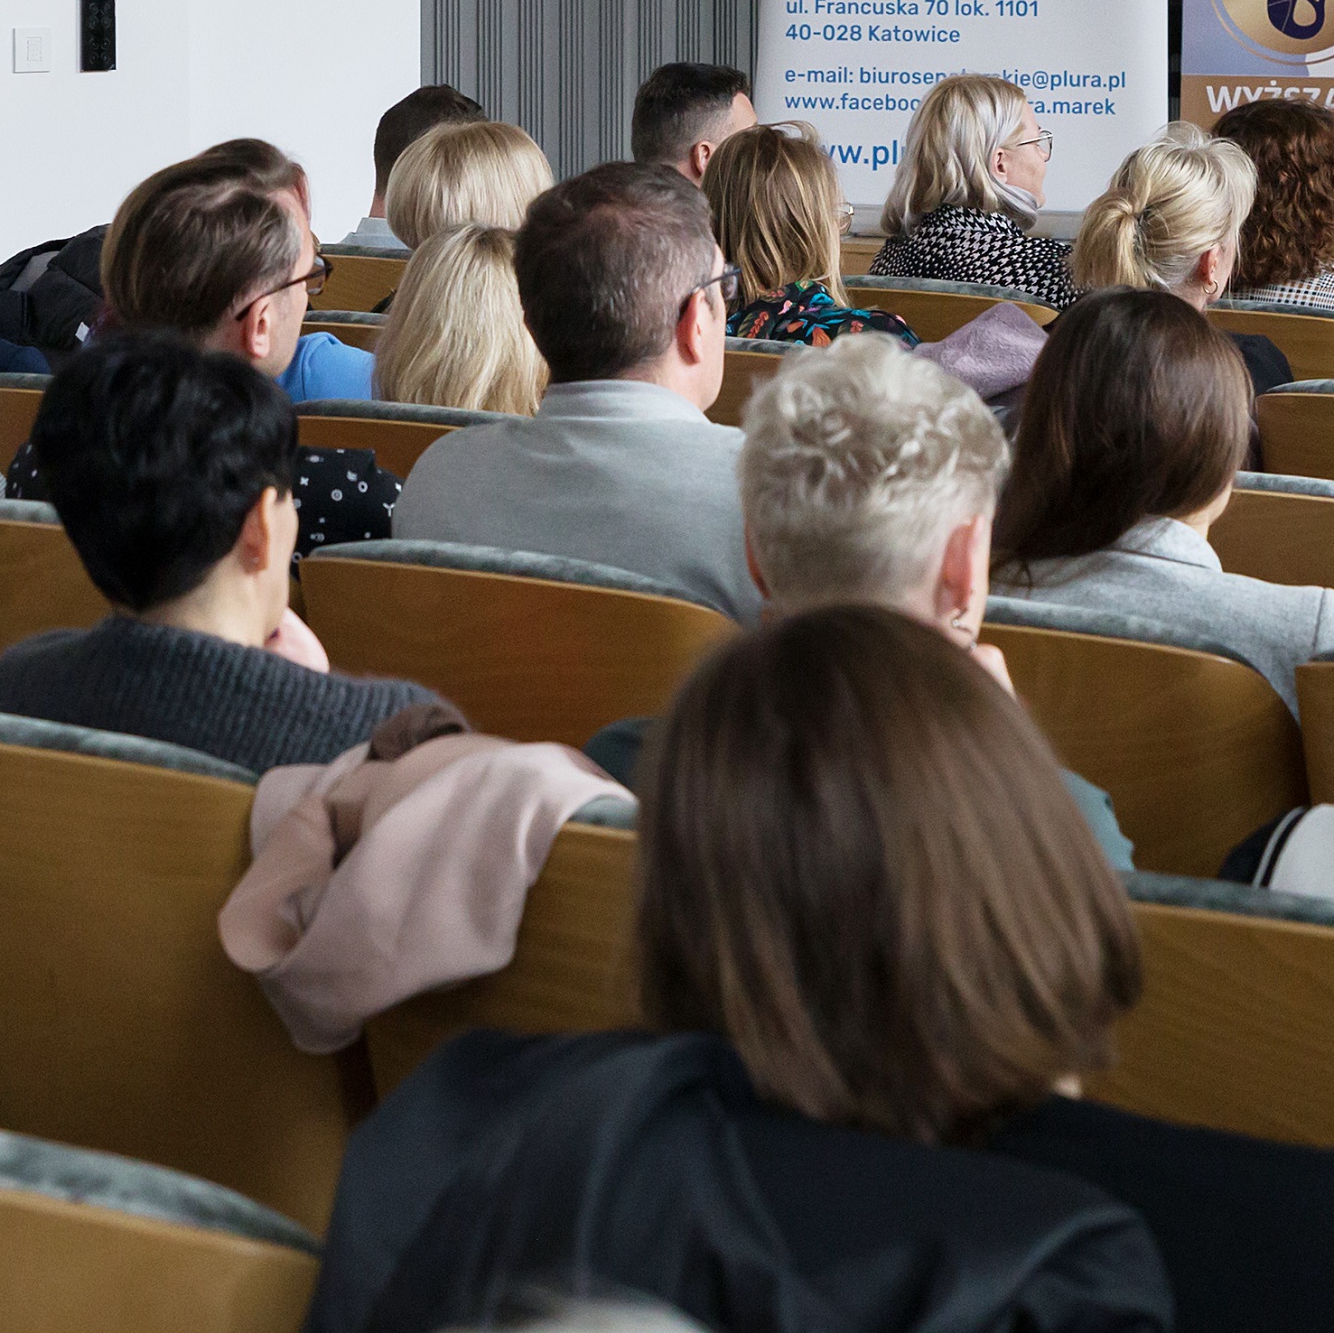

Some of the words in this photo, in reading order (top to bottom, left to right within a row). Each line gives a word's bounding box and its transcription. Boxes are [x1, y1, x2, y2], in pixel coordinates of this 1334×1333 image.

[925, 0, 948, 15] 70
[956, 0, 989, 16] lok.
[996, 0, 1037, 16] 1101
[786, 24, 862, 41] 40-028
[869, 25, 960, 42] Katowice
[785, 67, 853, 83] e-mail:
